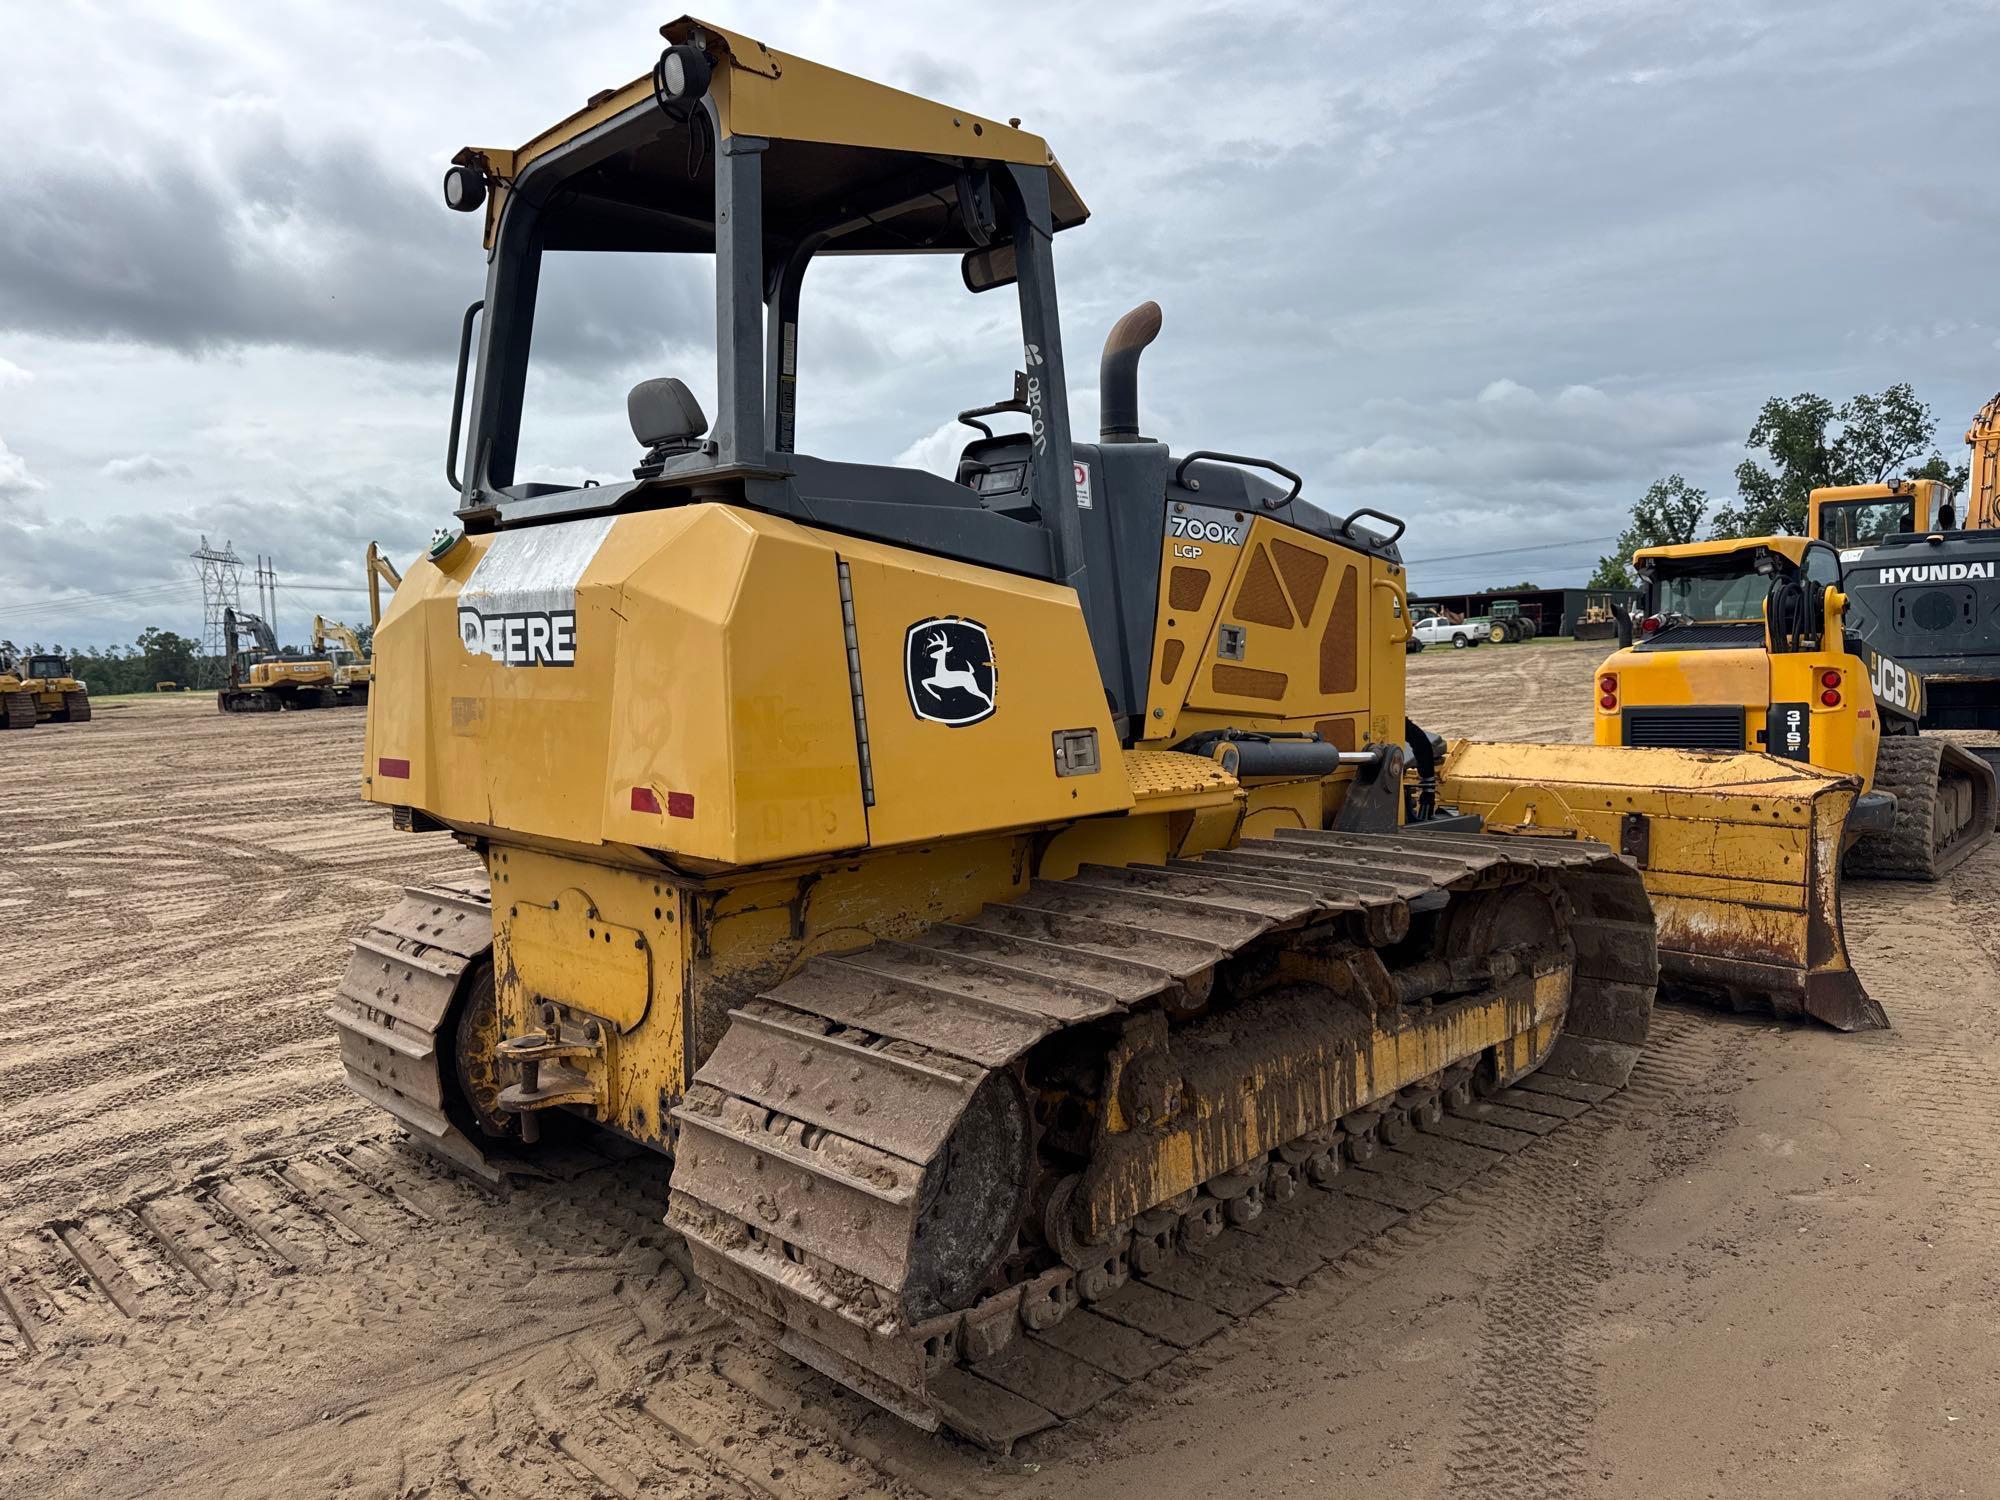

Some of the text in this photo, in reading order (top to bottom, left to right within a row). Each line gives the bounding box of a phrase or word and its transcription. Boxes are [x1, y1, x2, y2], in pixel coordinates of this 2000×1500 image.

[1171, 516, 1240, 545] 700K
[1173, 544, 1203, 558] LGP
[1879, 562, 1995, 584] HYUNDAI
[459, 609, 575, 664] DEERE
[1871, 654, 1906, 708] JCB
